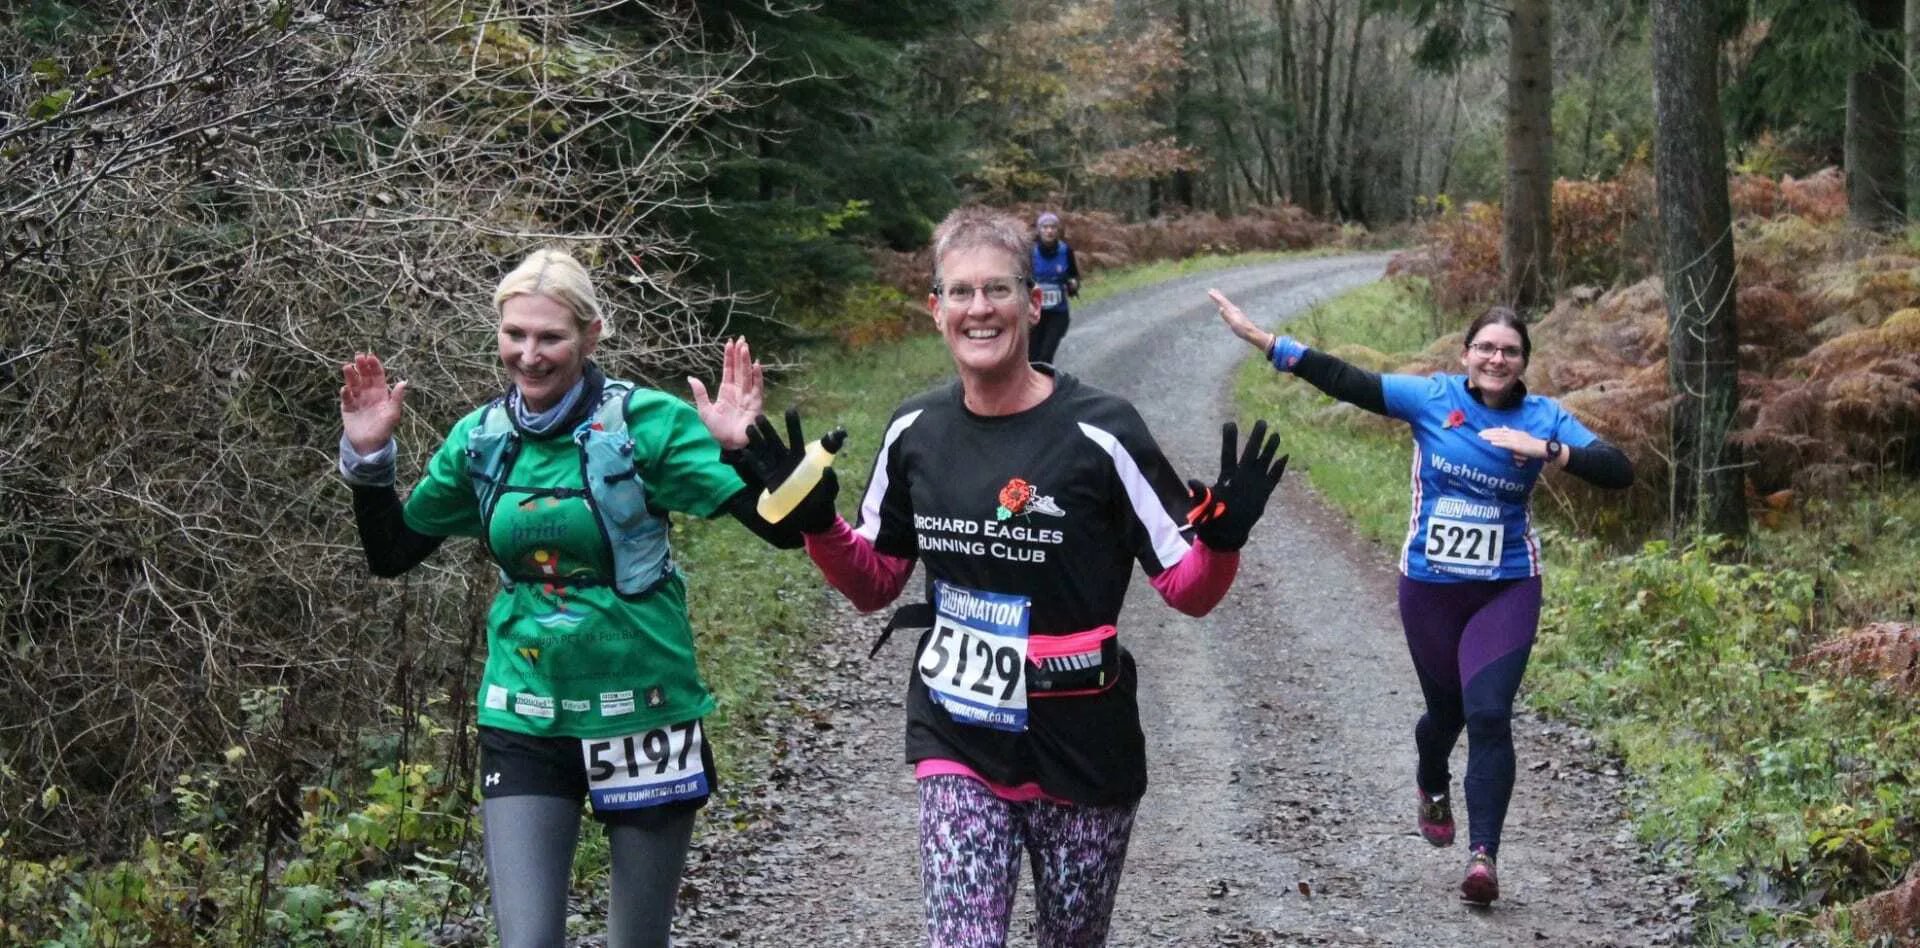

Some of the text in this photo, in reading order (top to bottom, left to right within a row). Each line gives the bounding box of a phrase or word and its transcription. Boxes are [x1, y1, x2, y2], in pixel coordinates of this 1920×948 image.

[1431, 453, 1524, 492] Washington
[914, 513, 1064, 544] ORCHARD EAGLES
[1427, 524, 1497, 561] 5221
[918, 533, 1046, 563] RUNNING CLUB
[921, 626, 1021, 701] 5129
[589, 719, 696, 782] 5197
[603, 781, 698, 804] WWW.RUNNATION.CO.UK
